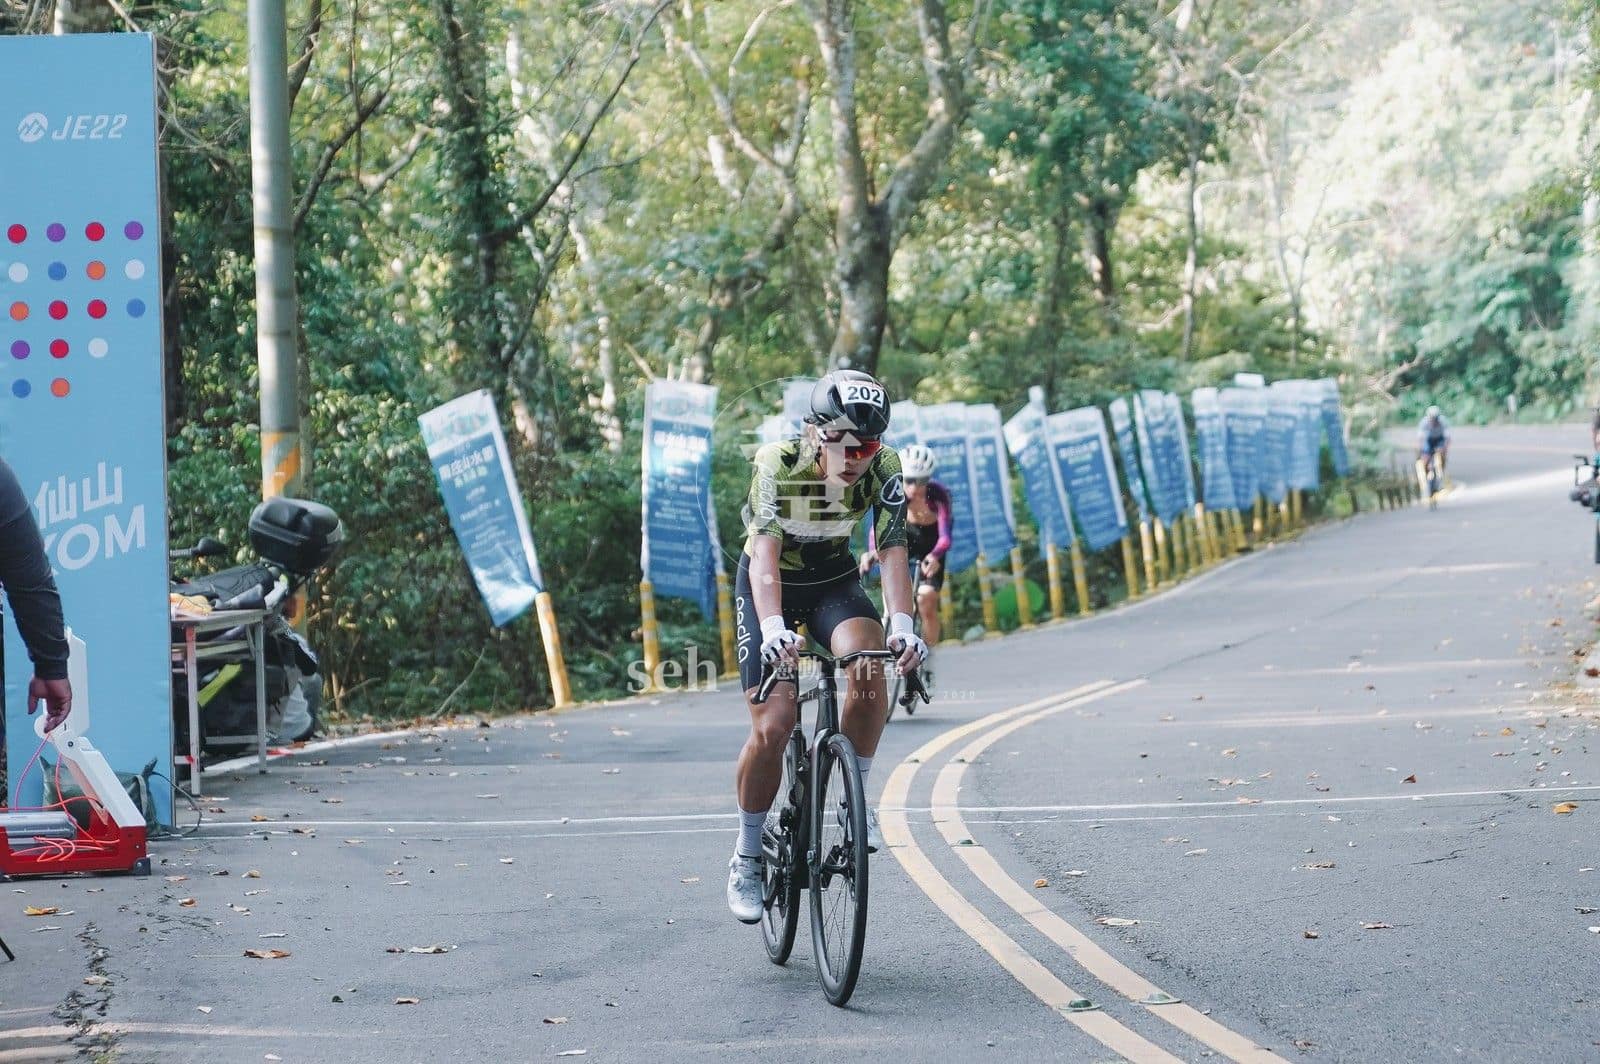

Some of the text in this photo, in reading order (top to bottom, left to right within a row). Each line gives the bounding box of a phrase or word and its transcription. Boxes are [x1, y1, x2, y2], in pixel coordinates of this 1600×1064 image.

[51, 114, 128, 140] JE22
[848, 386, 881, 404] 202
[34, 461, 122, 529] 仙山
